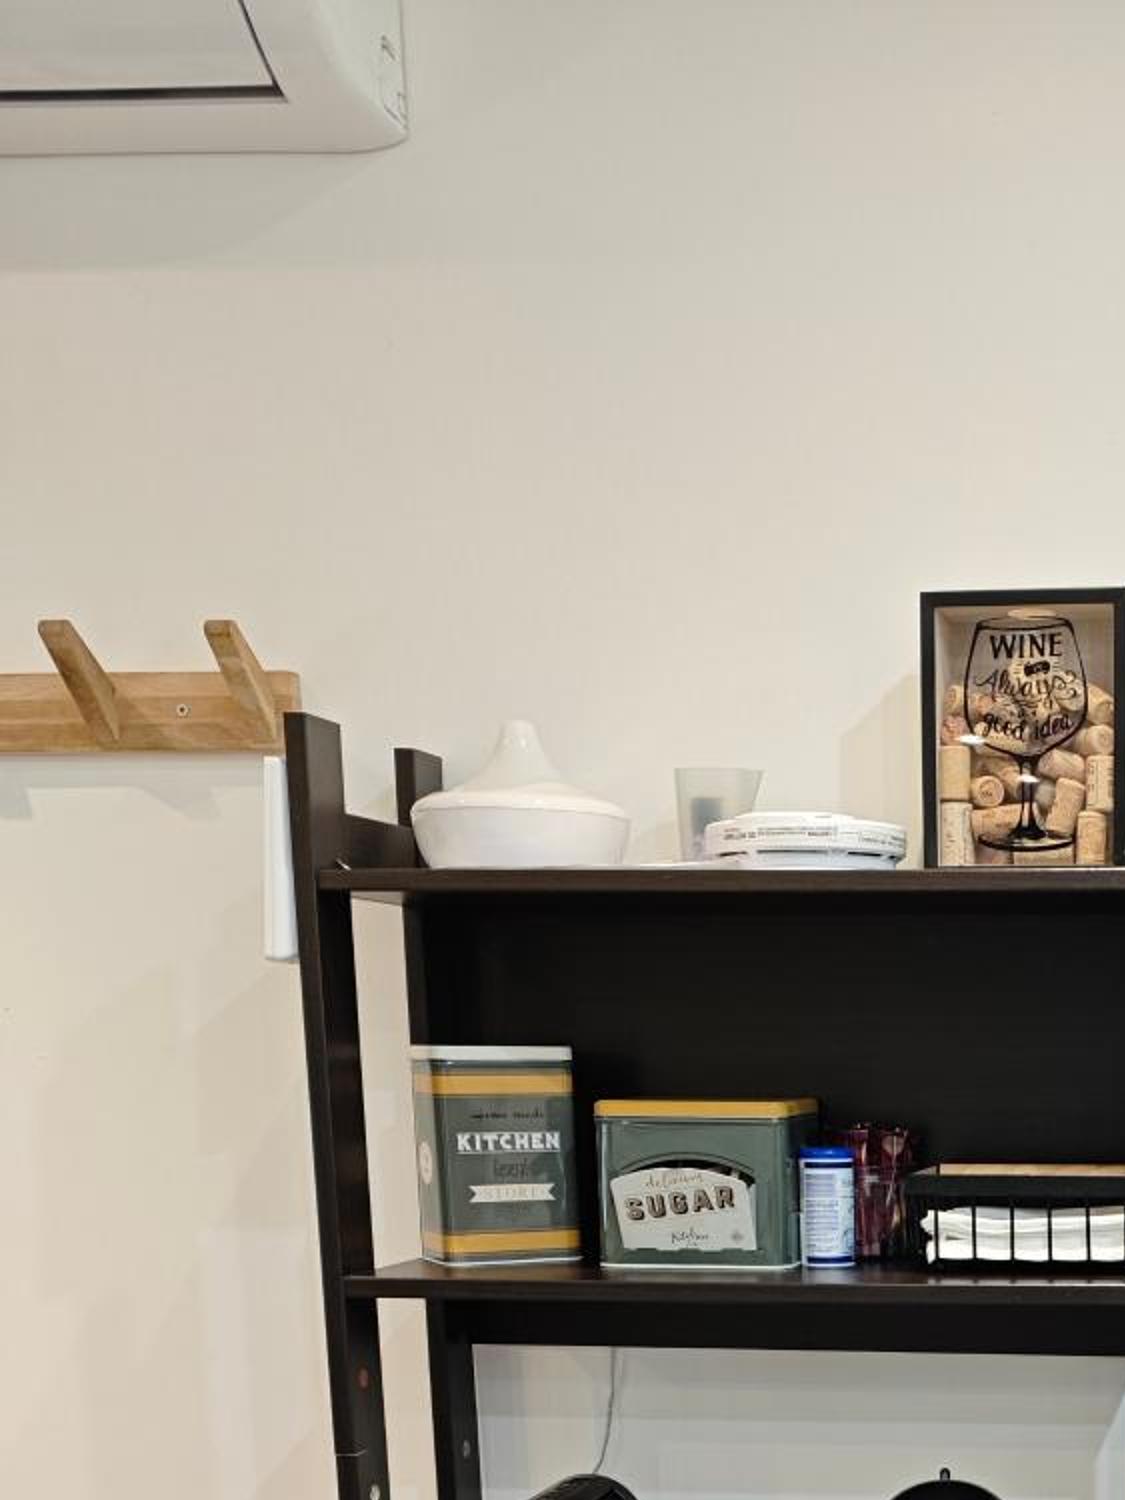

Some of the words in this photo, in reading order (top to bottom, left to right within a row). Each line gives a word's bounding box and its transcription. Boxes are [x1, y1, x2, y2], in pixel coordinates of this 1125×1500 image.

[989, 633, 1063, 659] WINE
[982, 713, 1025, 742] good
[1034, 713, 1073, 740] idea
[457, 1132, 560, 1152] KITCHEN
[625, 1186, 735, 1221] SUGAR
